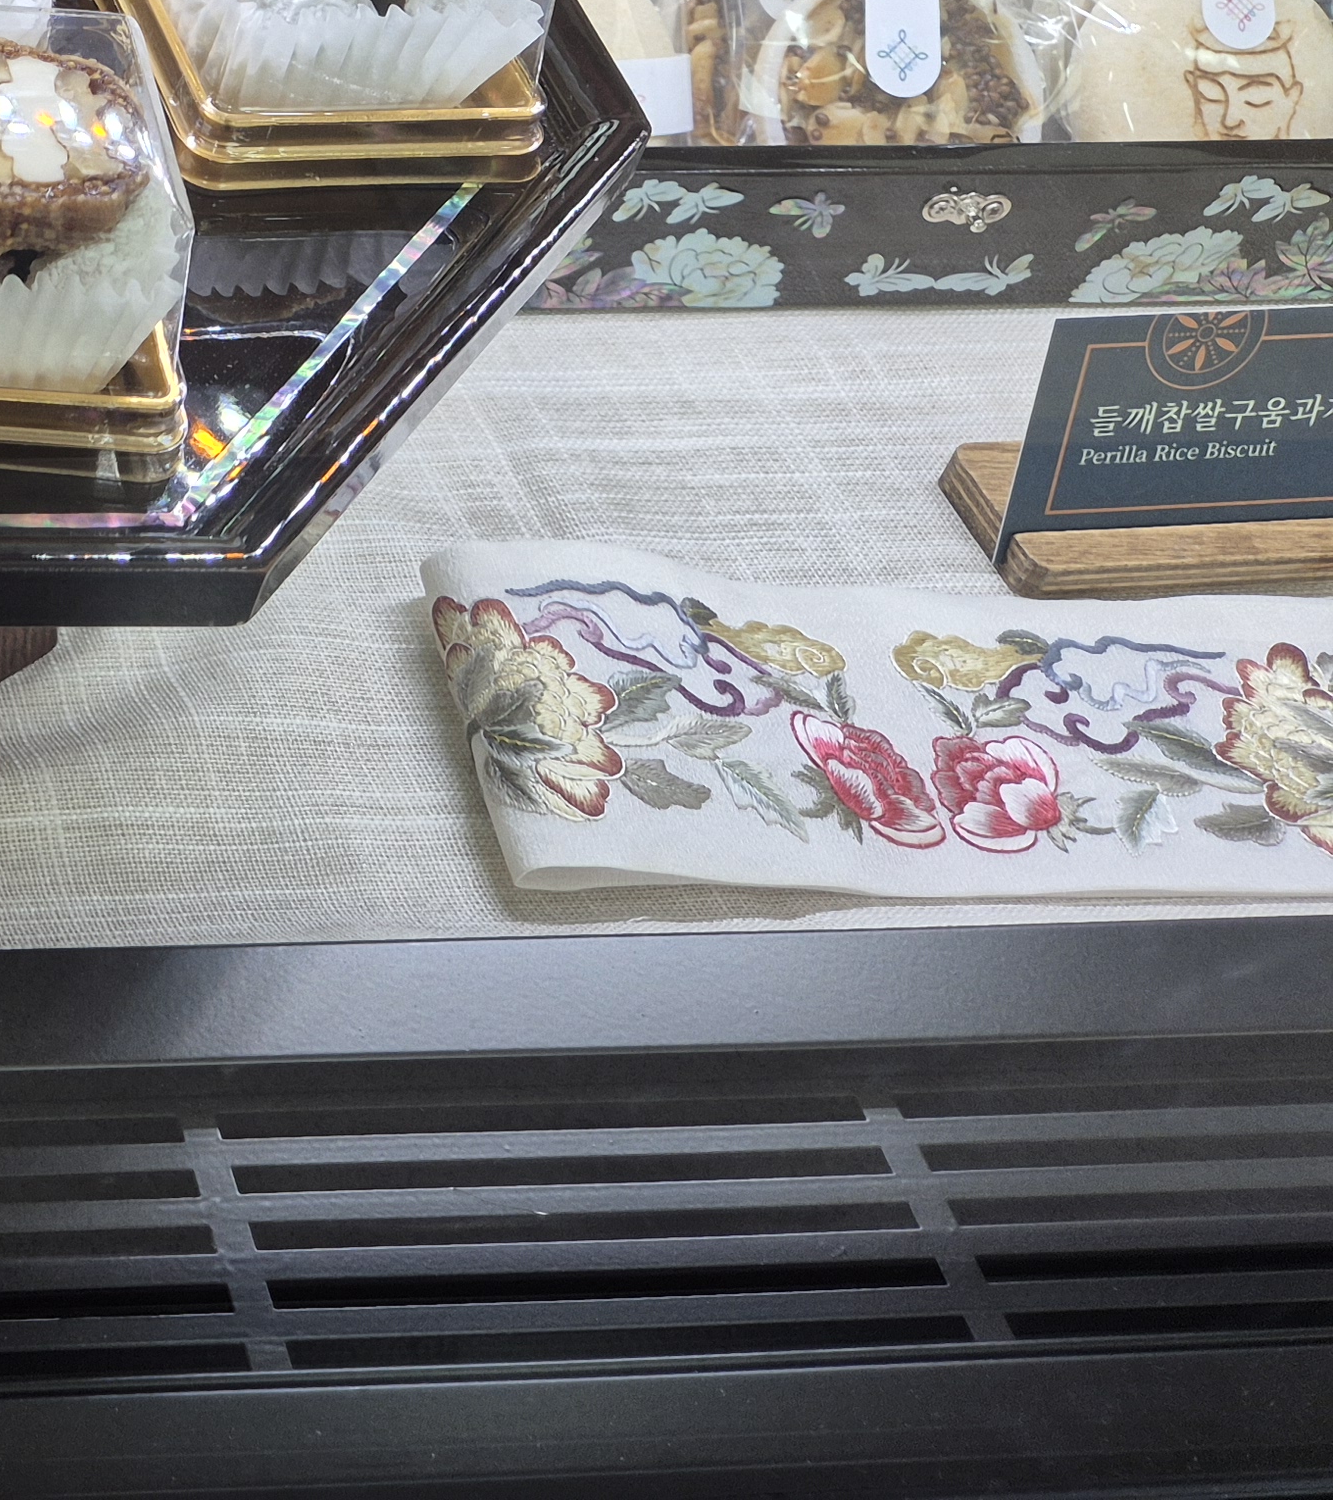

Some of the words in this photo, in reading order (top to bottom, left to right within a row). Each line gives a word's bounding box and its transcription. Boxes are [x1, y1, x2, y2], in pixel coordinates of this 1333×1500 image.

[1079, 444, 1147, 466] Perilla
[1153, 442, 1200, 462] Rice
[1203, 437, 1278, 460] Biscuit
